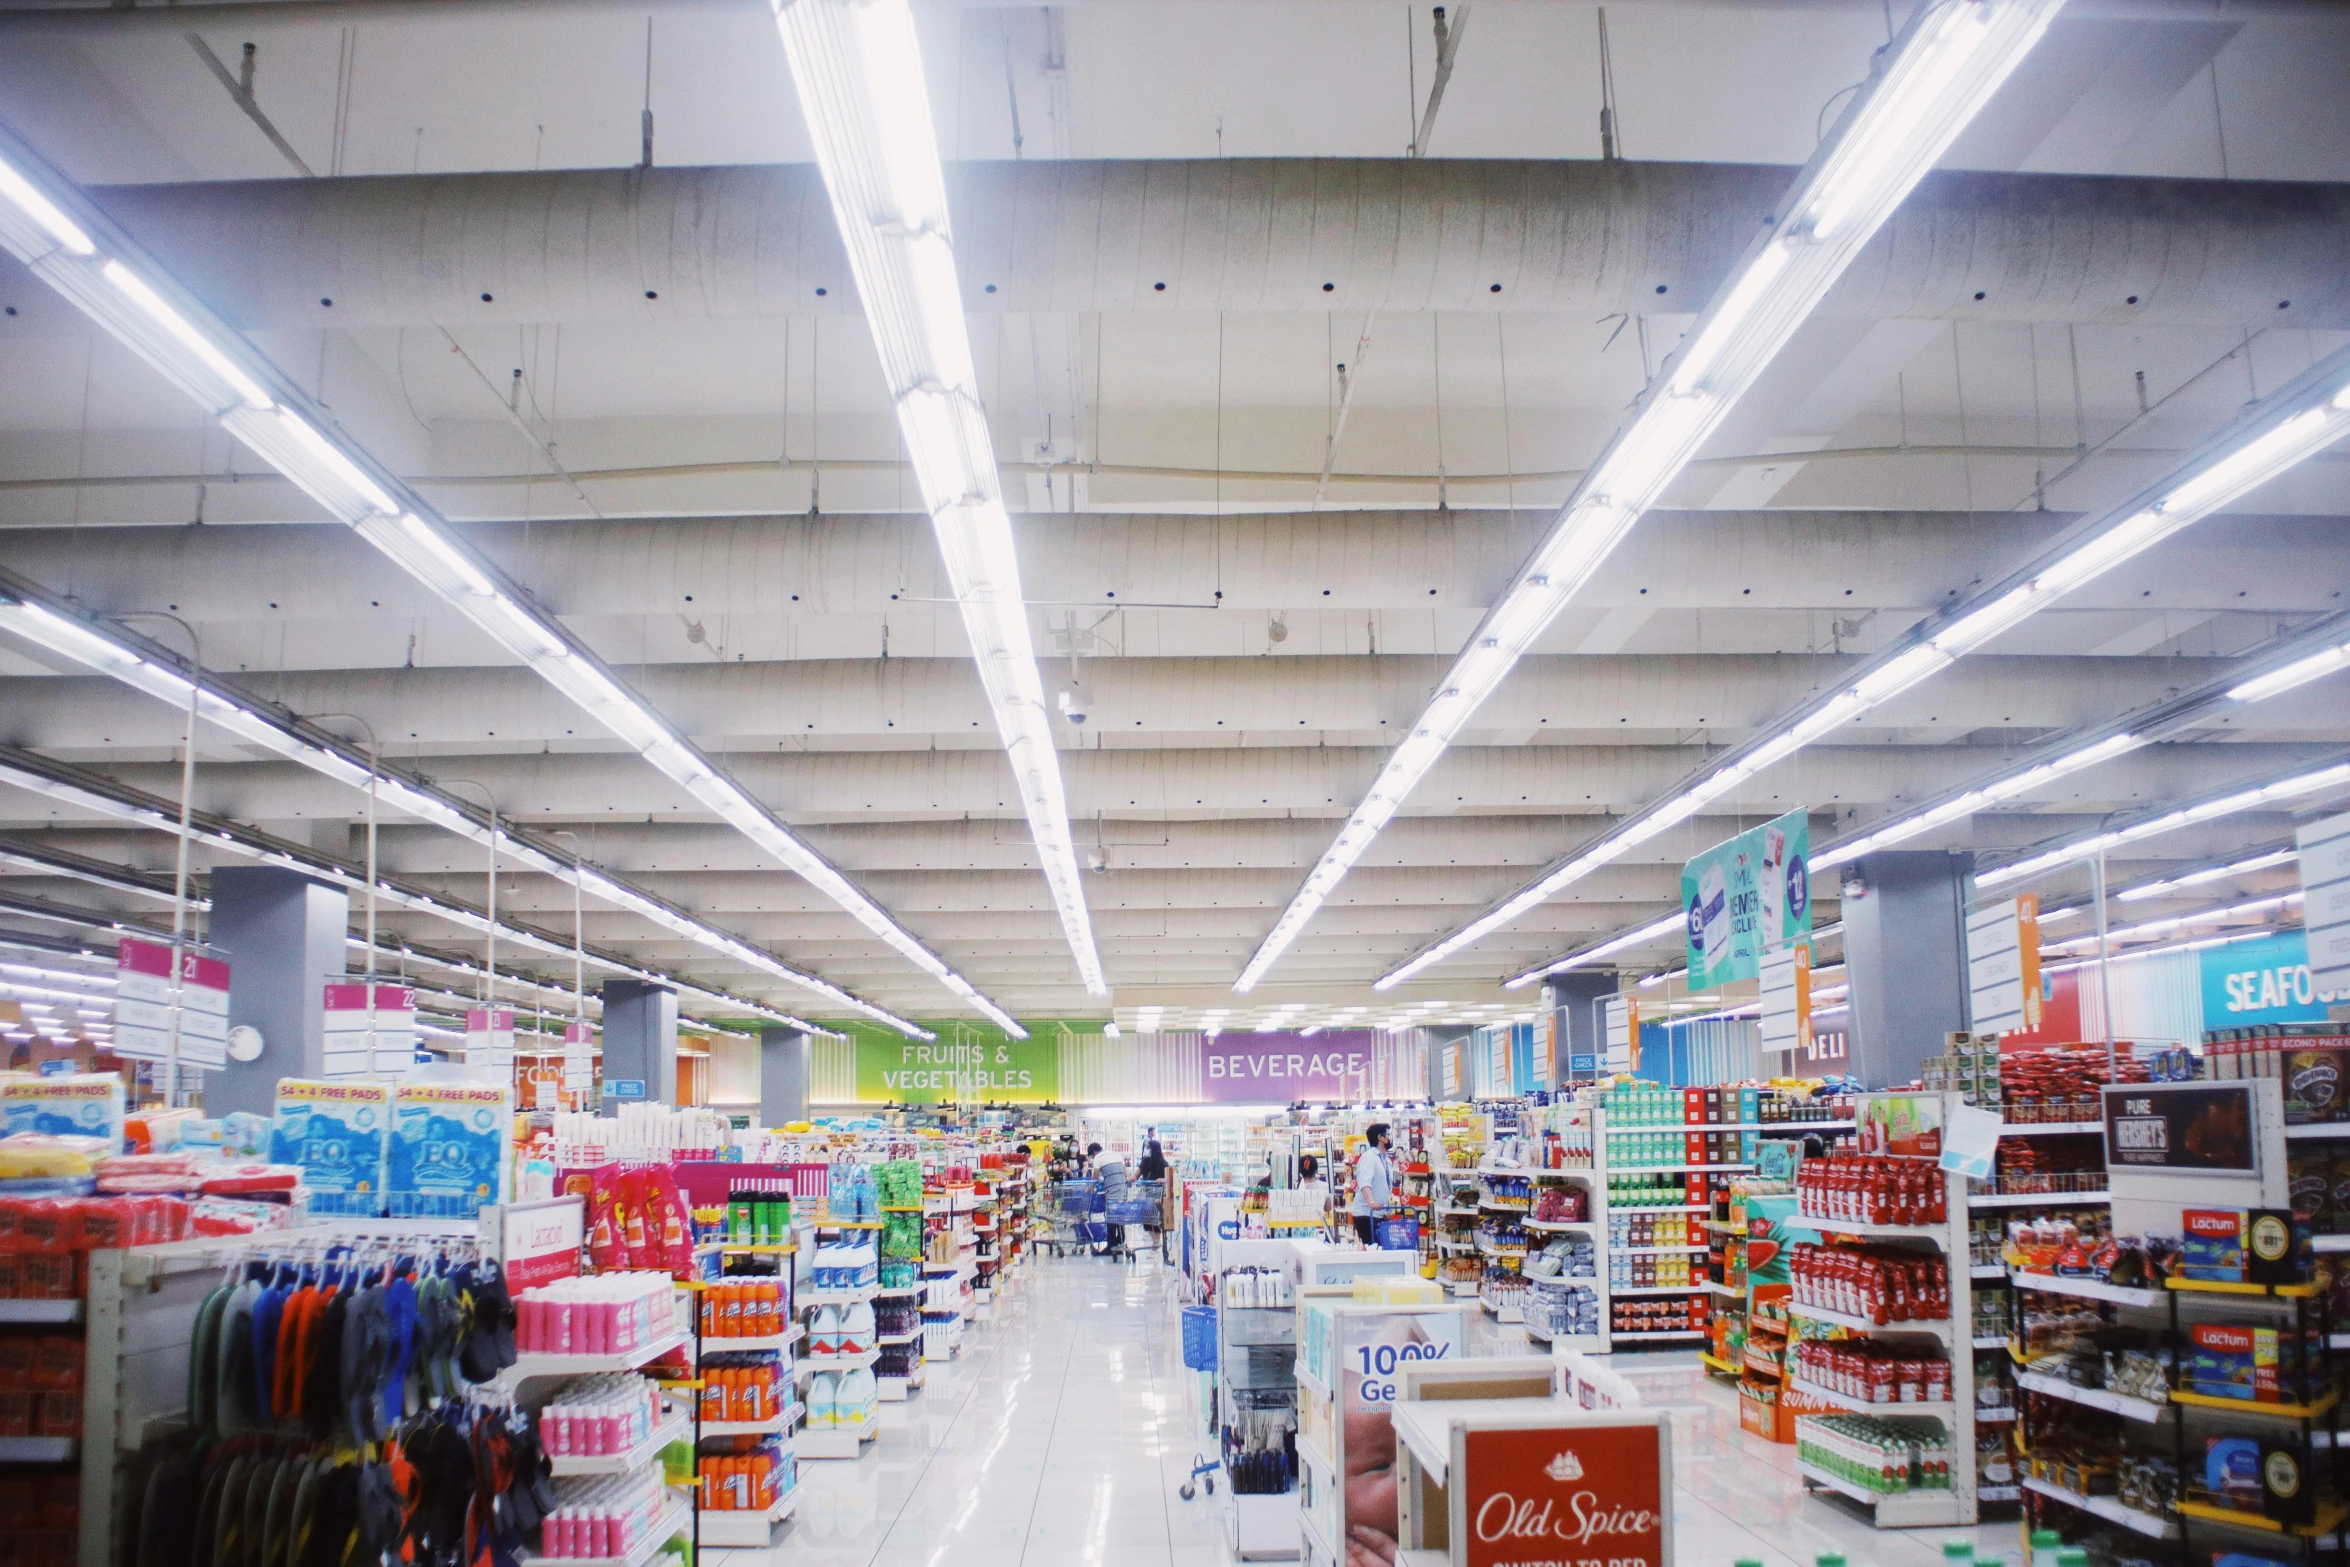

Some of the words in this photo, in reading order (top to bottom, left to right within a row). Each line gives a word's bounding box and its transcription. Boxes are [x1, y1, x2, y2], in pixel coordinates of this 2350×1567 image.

[184, 956, 197, 979] 21
[1796, 950, 1807, 968] 40
[2226, 964, 2350, 1012] SEAFO
[402, 989, 415, 1007] 22
[2282, 1038, 2316, 1048] ECONO
[2319, 1038, 2343, 1047] PACK
[902, 1045, 984, 1064] FRUITS
[995, 1045, 1010, 1064] &
[1208, 1053, 1363, 1078] BEVERAGE
[883, 1070, 1032, 1089] VEGETABLES
[45, 1086, 71, 1096] FREE
[75, 1085, 107, 1096] PADS
[281, 1085, 296, 1097] 54
[298, 1087, 306, 1096] +
[308, 1087, 317, 1098] 4
[321, 1087, 347, 1099] FREE
[350, 1089, 382, 1101] PADS
[398, 1087, 412, 1098] 54
[415, 1089, 423, 1098] +
[426, 1088, 434, 1099] 4
[438, 1088, 465, 1100] FREE
[468, 1089, 500, 1101] PADS
[2125, 1100, 2151, 1115] PURE
[2117, 1120, 2167, 1148] HERSHEY'S
[1221, 1225, 1238, 1239] Hug
[2192, 1217, 2235, 1231] Lactum
[2202, 1331, 2249, 1347] Lactum
[1358, 1341, 1450, 1375] 100%
[2256, 1368, 2275, 1378] FREE
[1360, 1379, 1396, 1401] Ge
[1476, 1492, 1554, 1543] Old
